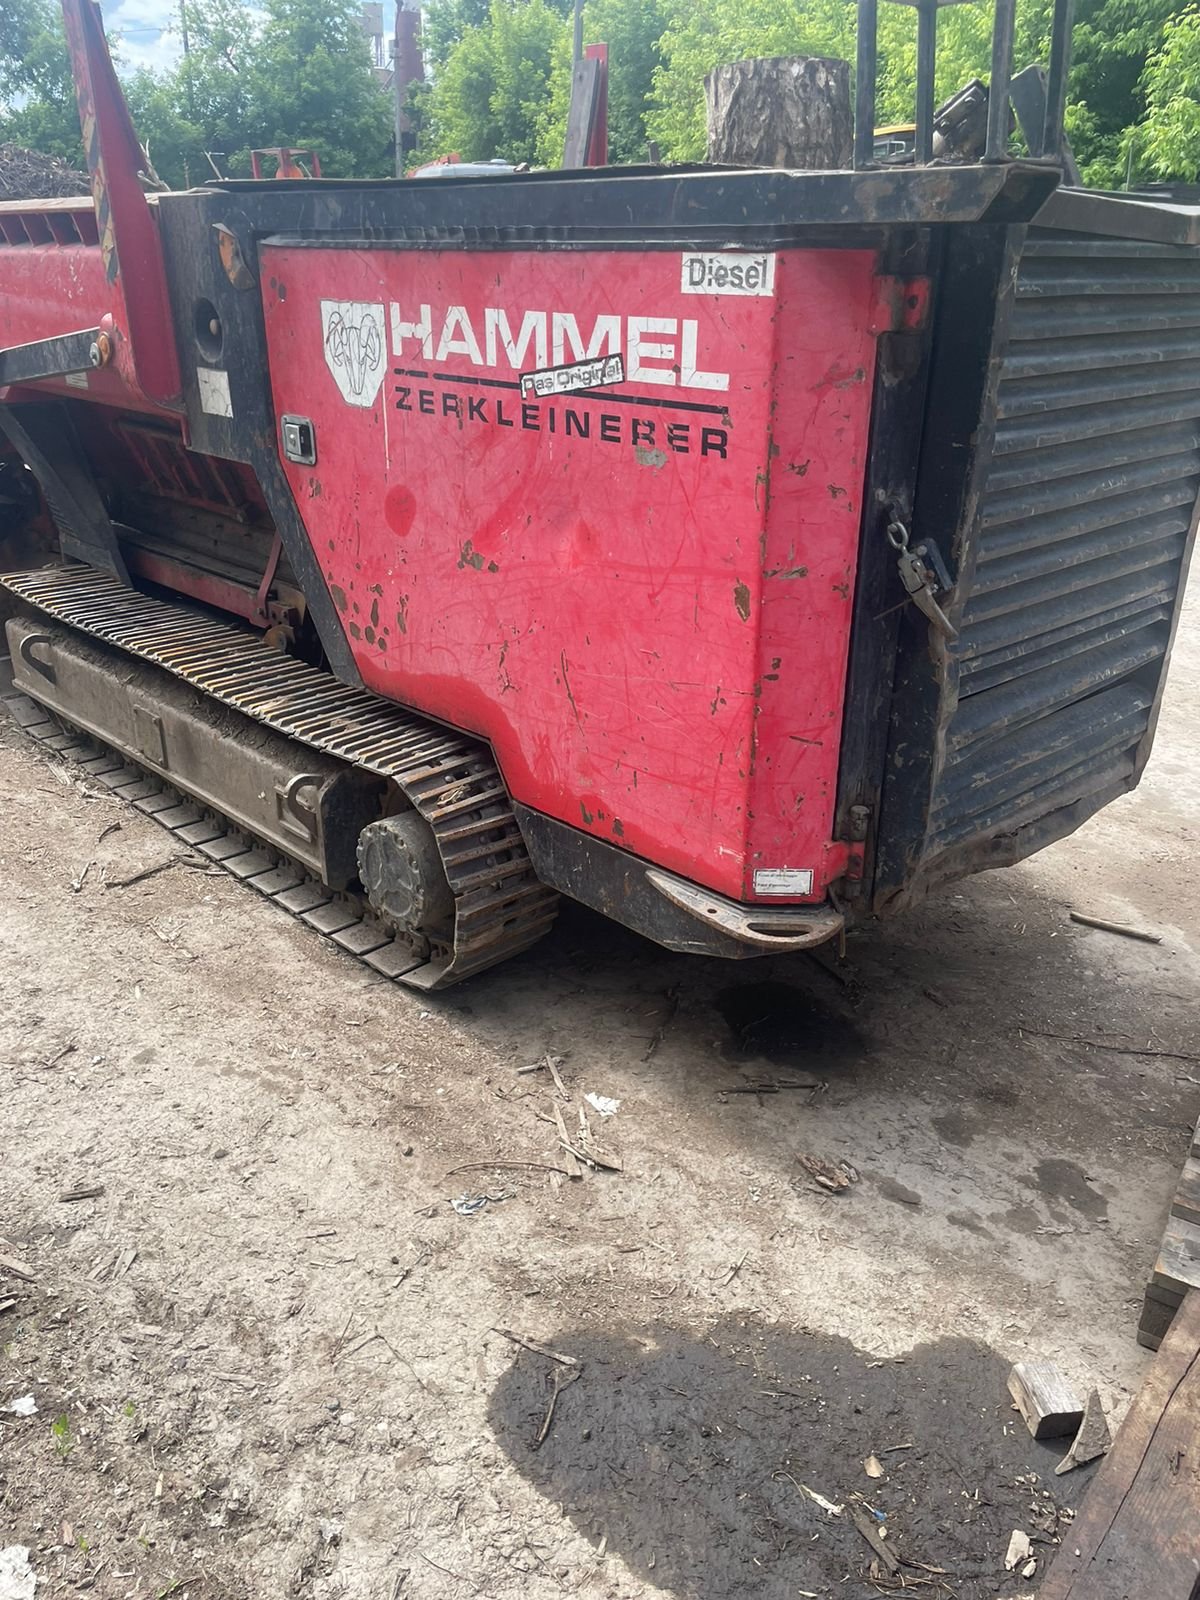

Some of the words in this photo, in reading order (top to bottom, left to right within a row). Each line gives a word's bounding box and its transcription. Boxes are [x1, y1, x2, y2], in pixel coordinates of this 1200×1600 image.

[689, 257, 768, 290] Diesel
[390, 301, 730, 391] HAMMEL
[556, 360, 621, 387] Original
[395, 386, 729, 460] ZERKLEINERER
